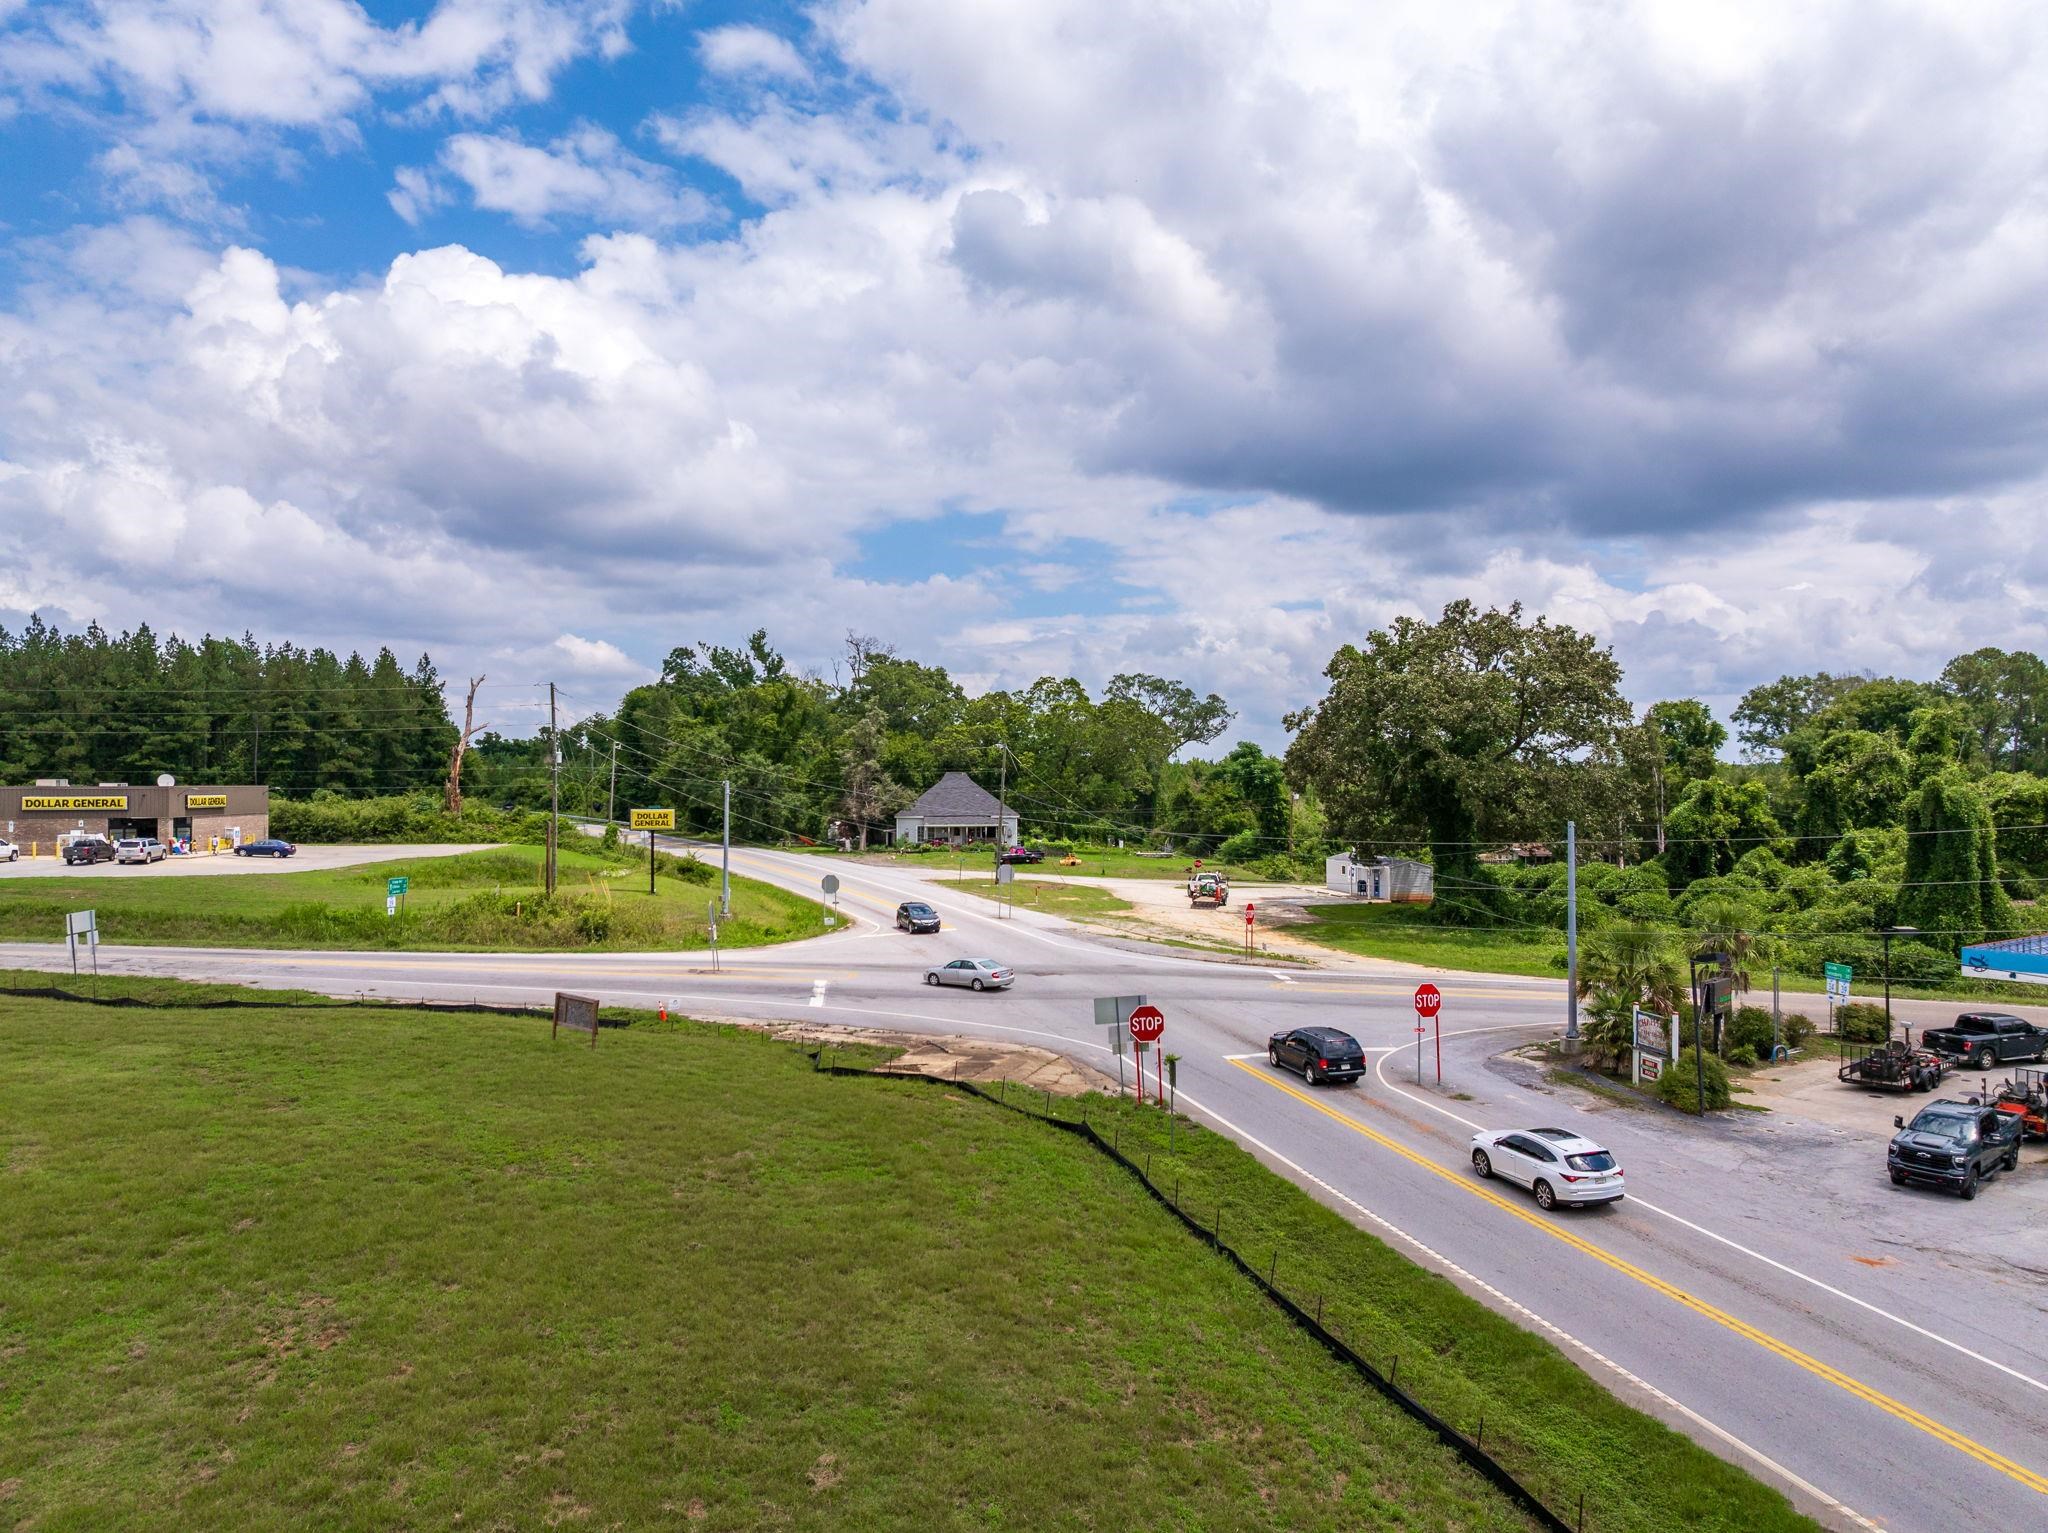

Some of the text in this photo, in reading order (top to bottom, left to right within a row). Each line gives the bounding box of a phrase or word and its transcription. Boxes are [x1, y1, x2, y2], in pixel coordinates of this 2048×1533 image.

[25, 799, 124, 808] DOLLAR GENERAL
[190, 797, 207, 806] DOLLAR
[1416, 994, 1440, 1008] STOP
[1131, 1016, 1162, 1032] STOP
